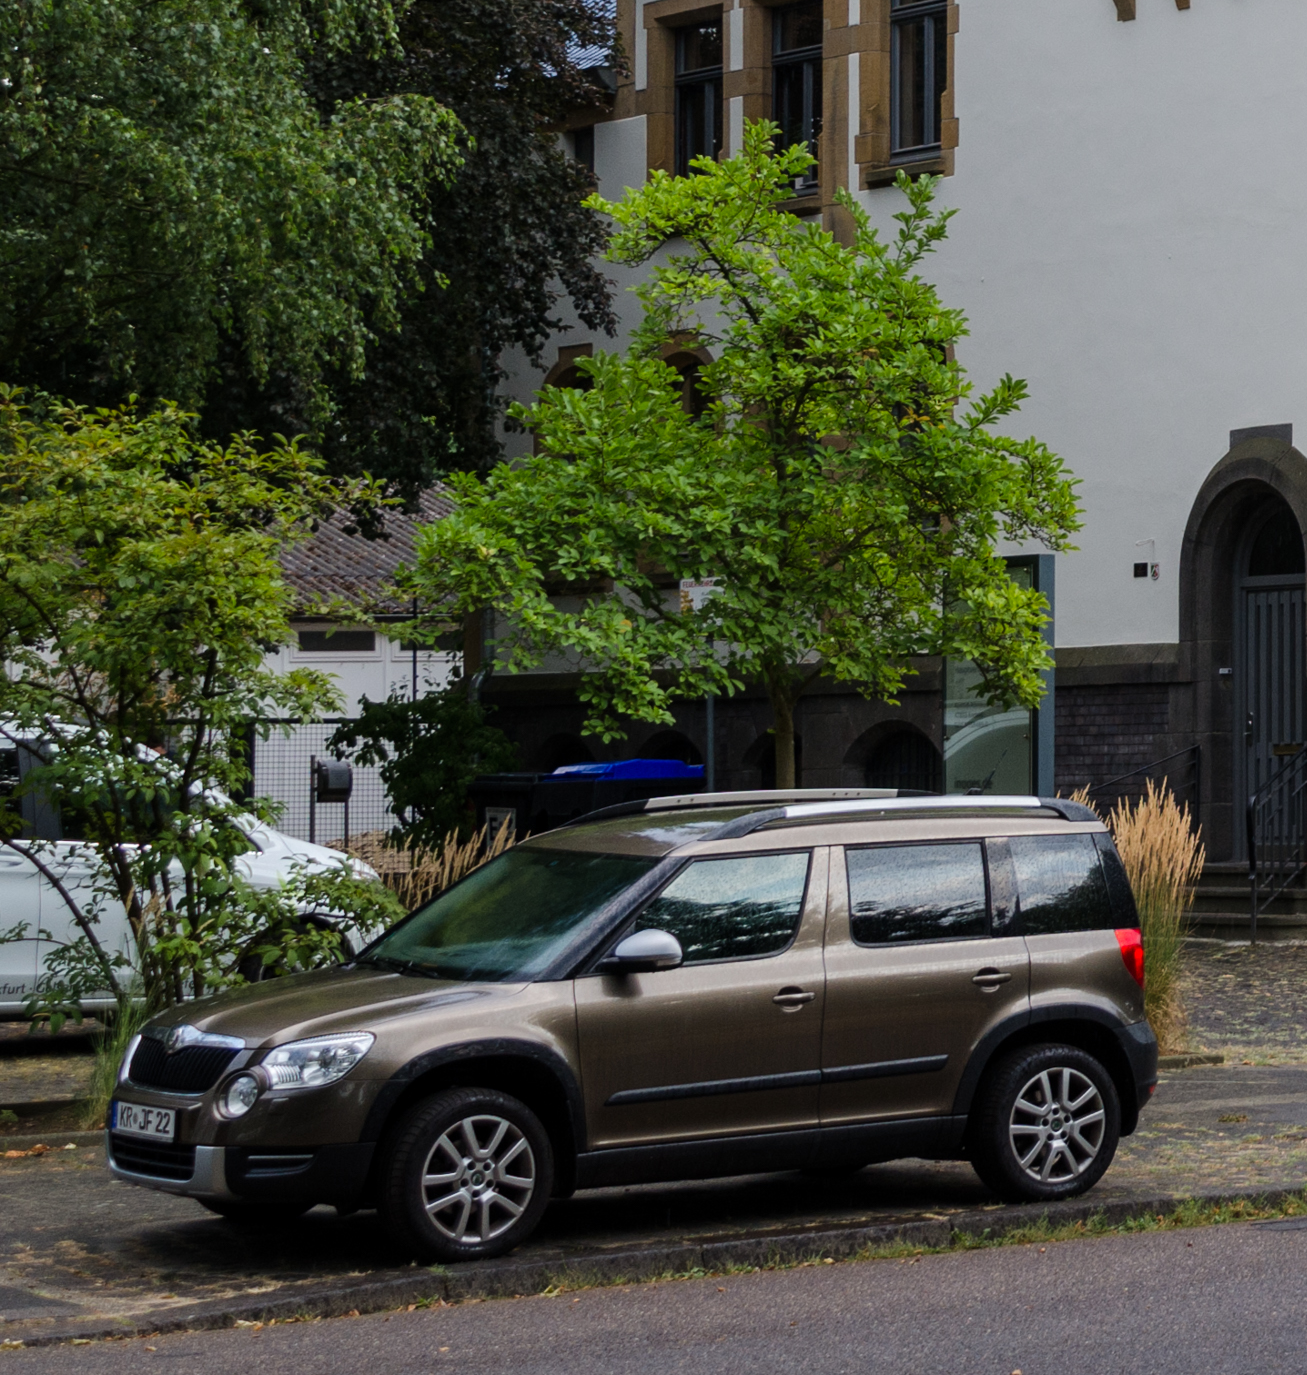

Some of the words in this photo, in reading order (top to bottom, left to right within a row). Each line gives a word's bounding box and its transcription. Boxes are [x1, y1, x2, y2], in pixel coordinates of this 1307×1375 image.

[120, 1105, 133, 1128] KR
[139, 1108, 154, 1131] JF
[156, 1110, 170, 1133] 22
